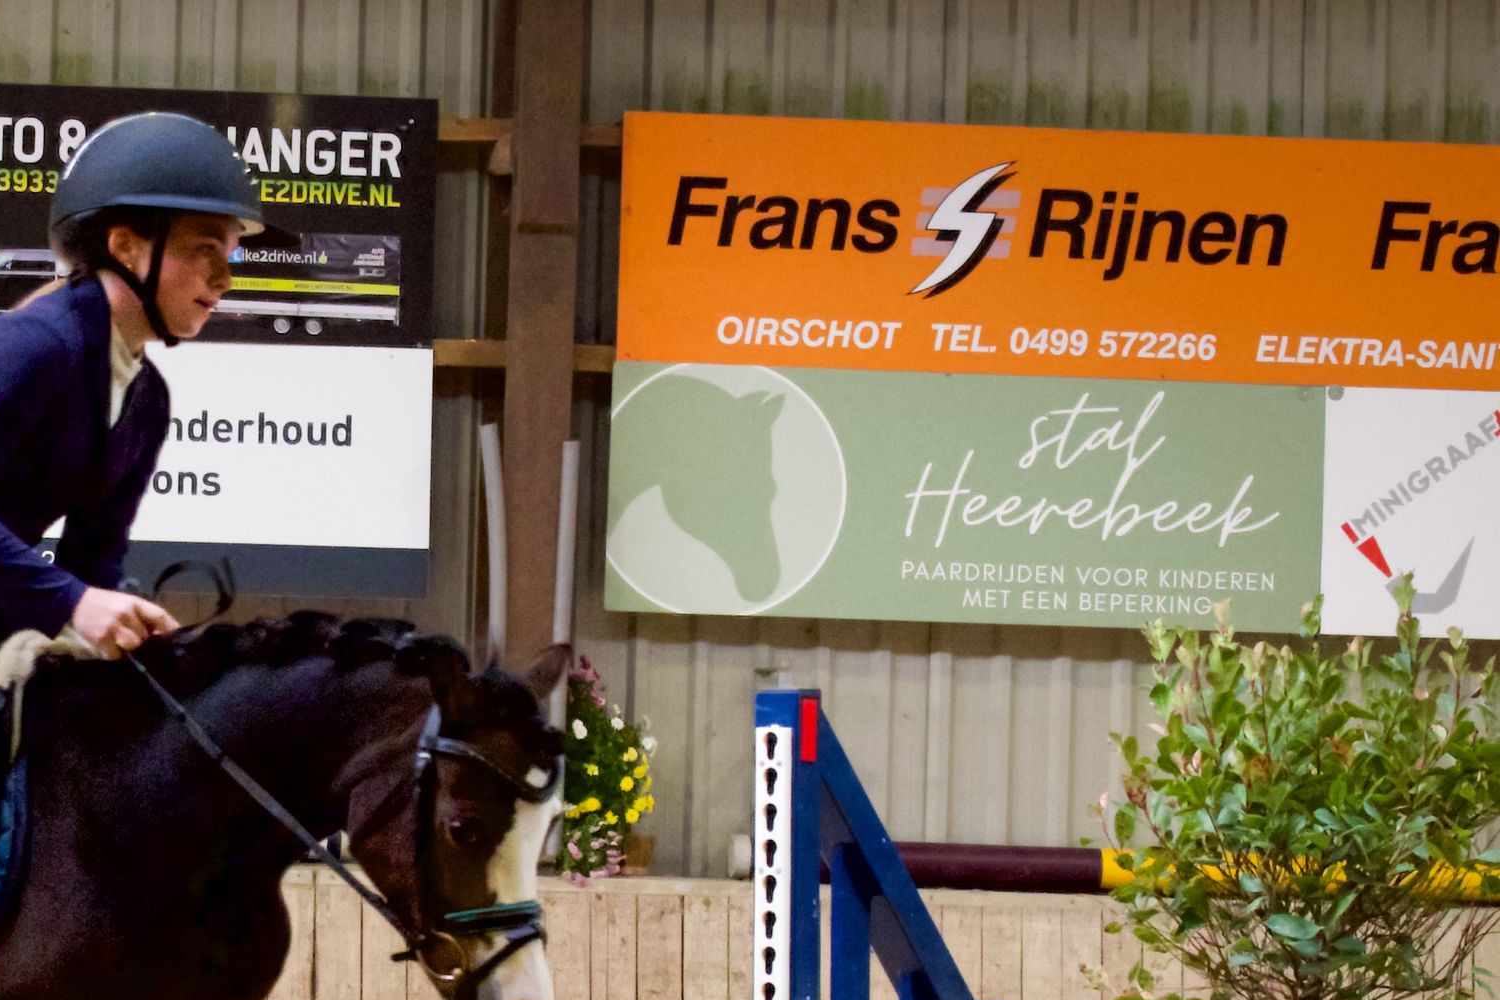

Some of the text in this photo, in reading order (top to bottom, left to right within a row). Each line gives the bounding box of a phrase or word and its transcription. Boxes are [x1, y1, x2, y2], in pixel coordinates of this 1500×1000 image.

[666, 175, 1289, 281] Frans Rijnen
[716, 316, 1500, 370] OIRSCHOT TEL. 0499 572266 ELEKTRA-SANI
[1018, 390, 1167, 471] stal
[904, 449, 1280, 548] Heerebeek
[900, 560, 1276, 592] PAARDRIJDEN VOOR KINDEREN
[962, 588, 1213, 616] MET EEN BEPERKING
